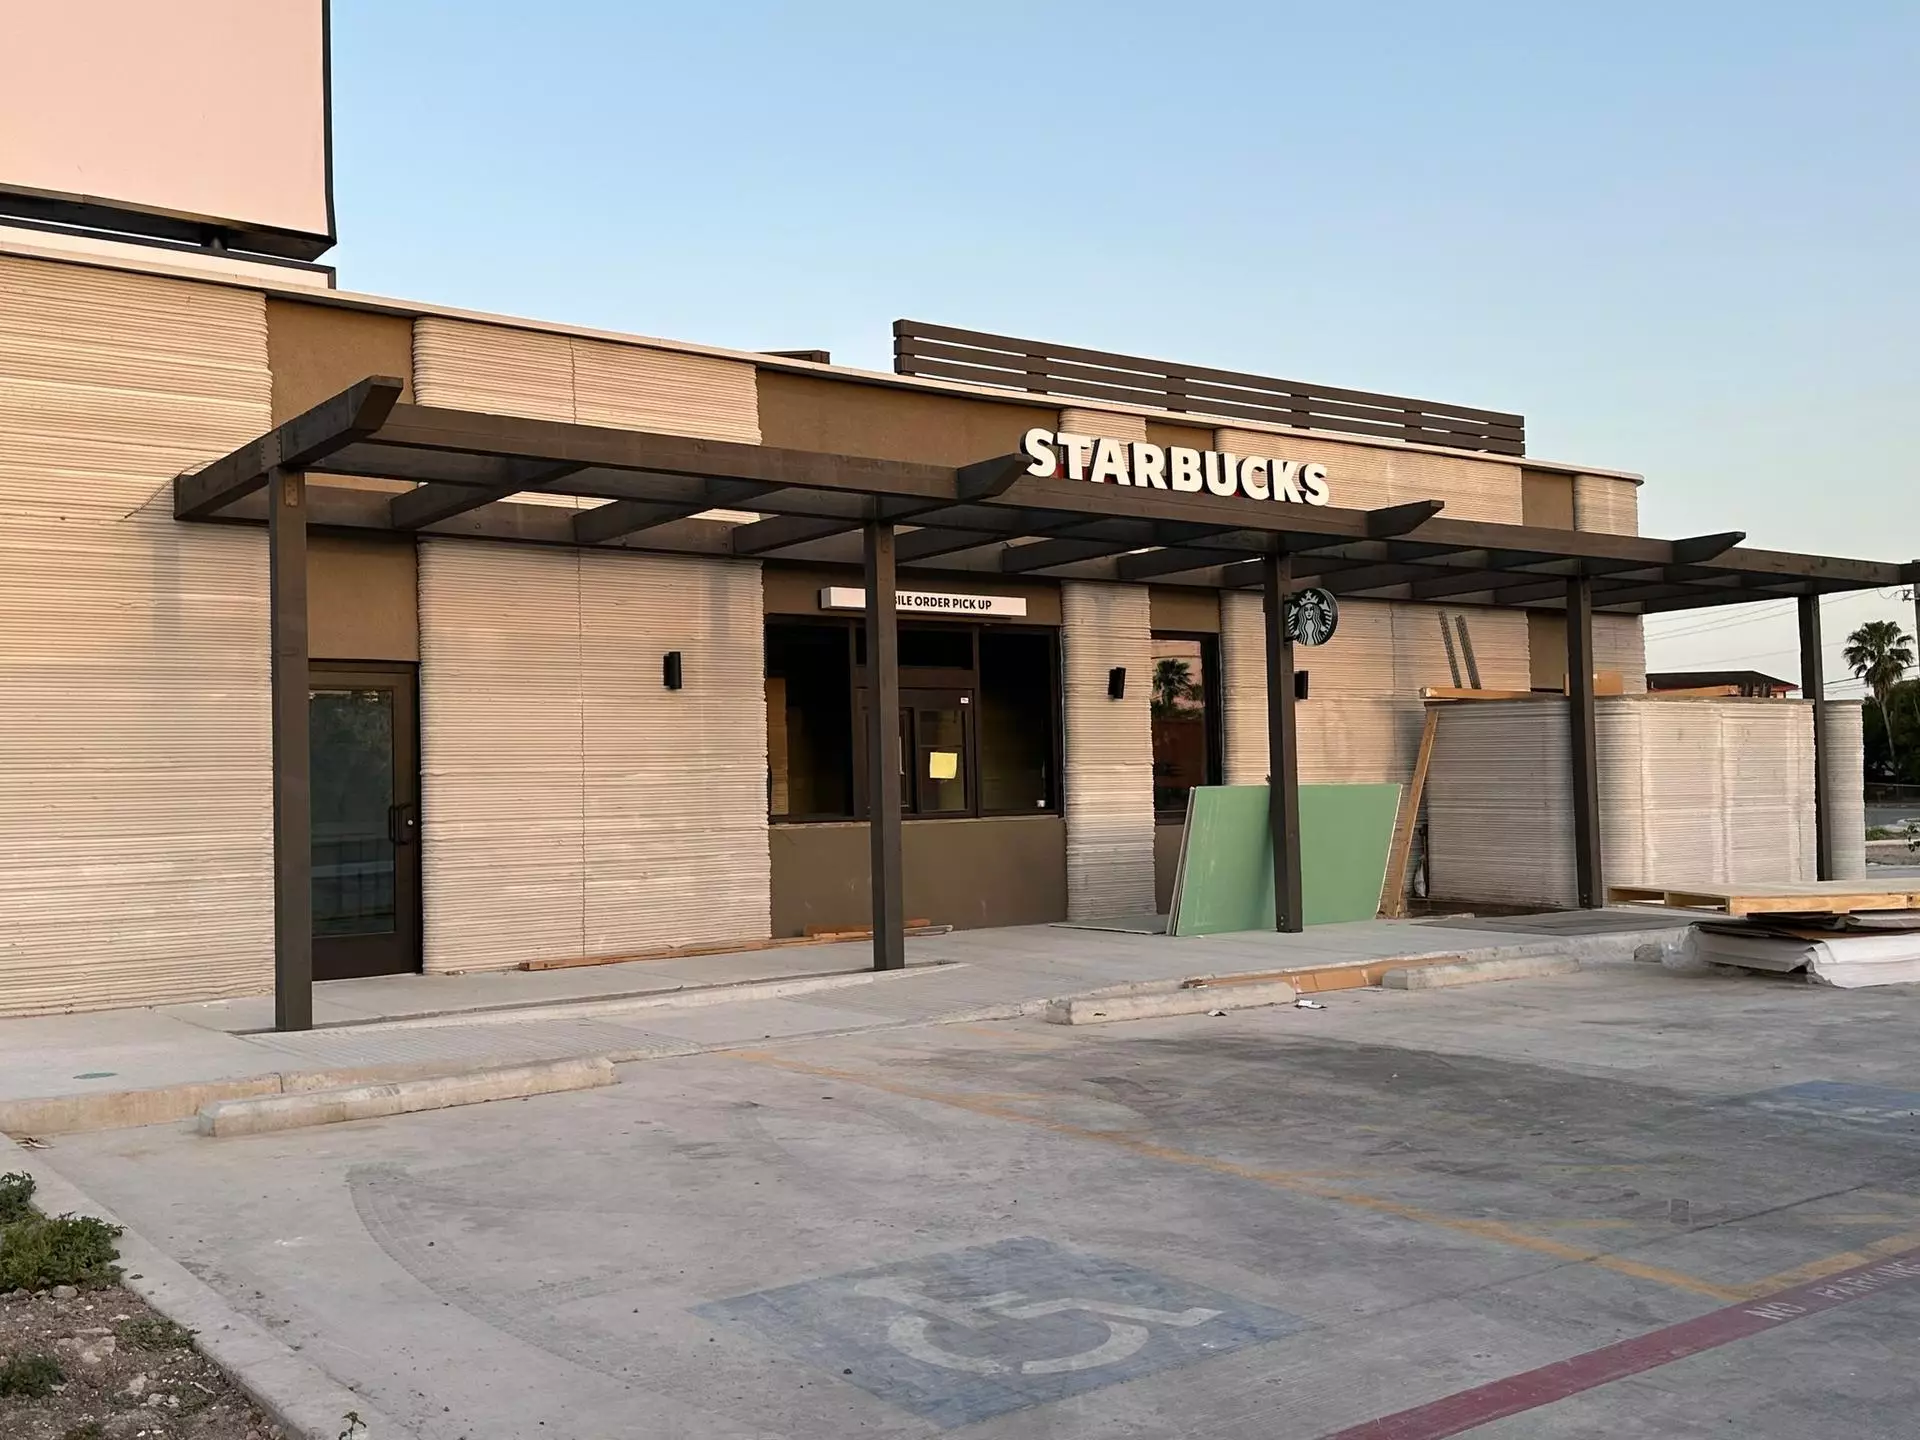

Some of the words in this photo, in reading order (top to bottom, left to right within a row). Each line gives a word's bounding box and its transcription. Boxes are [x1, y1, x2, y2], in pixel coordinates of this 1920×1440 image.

[1023, 428, 1330, 506] STARBUCKS
[914, 596, 950, 608] ORDER
[952, 598, 976, 609] PICK
[978, 600, 992, 610] UP
[1744, 1301, 1807, 1321] NO
